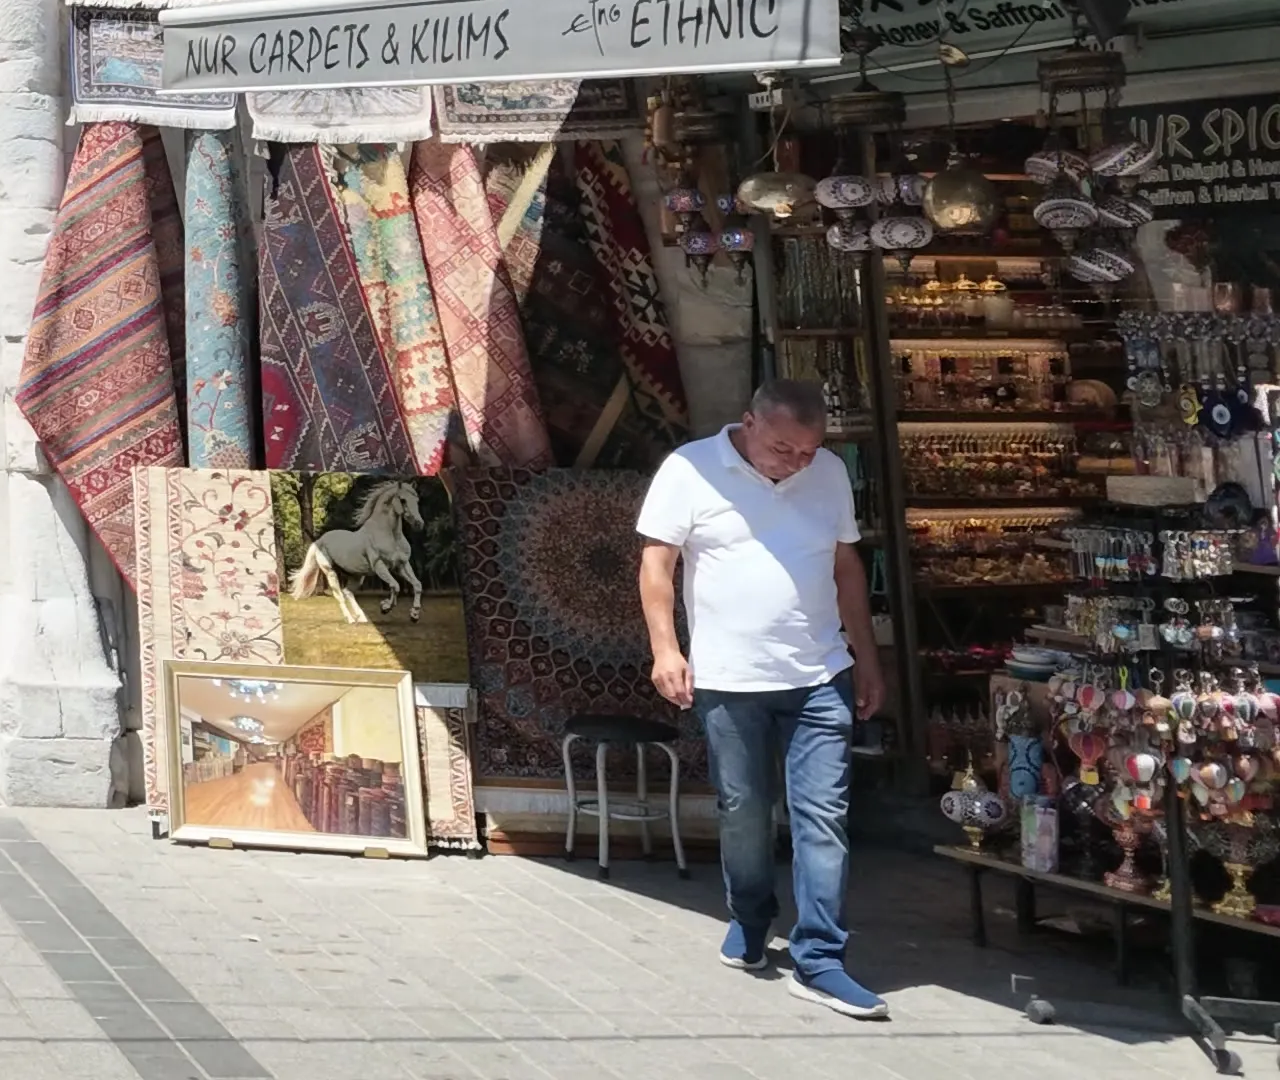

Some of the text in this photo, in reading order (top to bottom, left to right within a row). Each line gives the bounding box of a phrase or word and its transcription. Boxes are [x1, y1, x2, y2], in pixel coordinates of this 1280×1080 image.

[944, 11, 971, 33] &
[968, 0, 1066, 31] Saffron
[186, 34, 238, 78] NUR
[248, 23, 370, 75] CARPETS
[381, 22, 400, 65] &
[411, 9, 510, 64] KILIMS
[1214, 182, 1269, 202] Herbal
